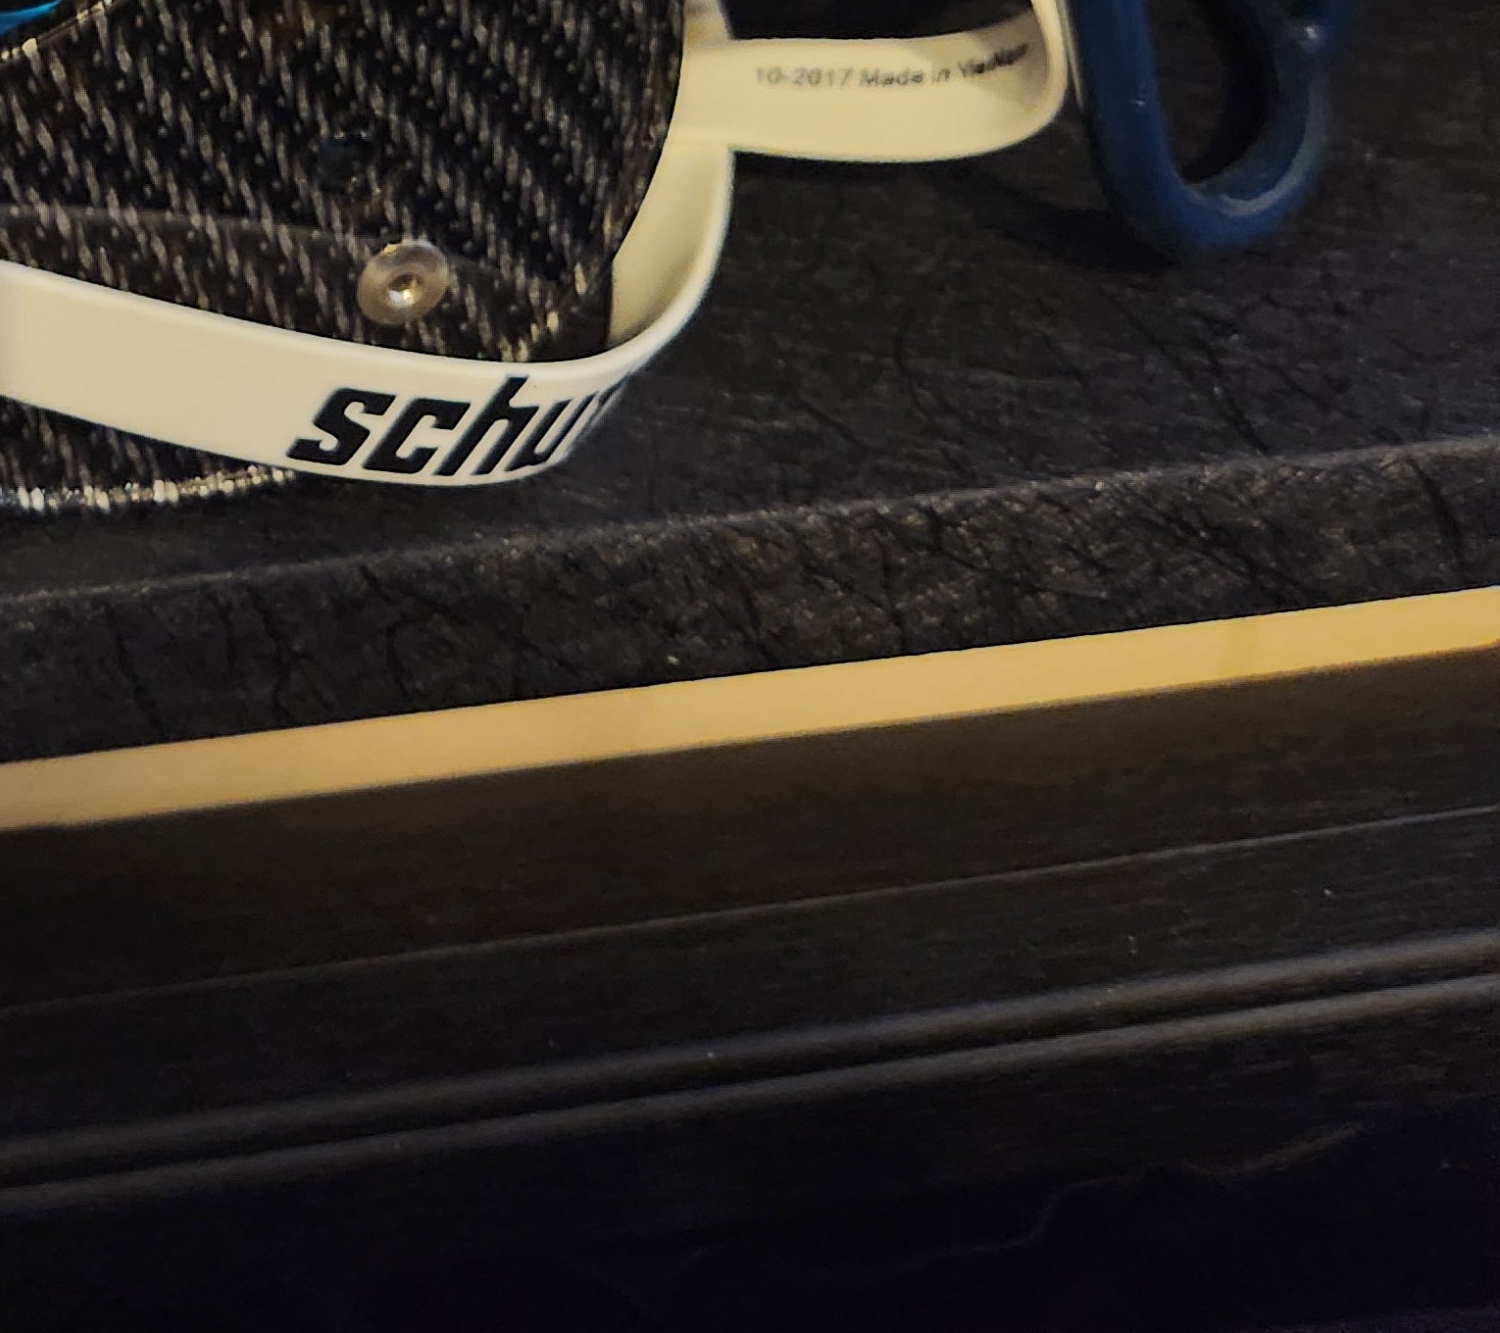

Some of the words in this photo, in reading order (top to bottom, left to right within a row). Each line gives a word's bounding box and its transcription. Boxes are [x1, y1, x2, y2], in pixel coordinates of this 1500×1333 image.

[755, 66, 853, 88] 10-2017
[860, 66, 924, 87] Made
[932, 66, 952, 85] in
